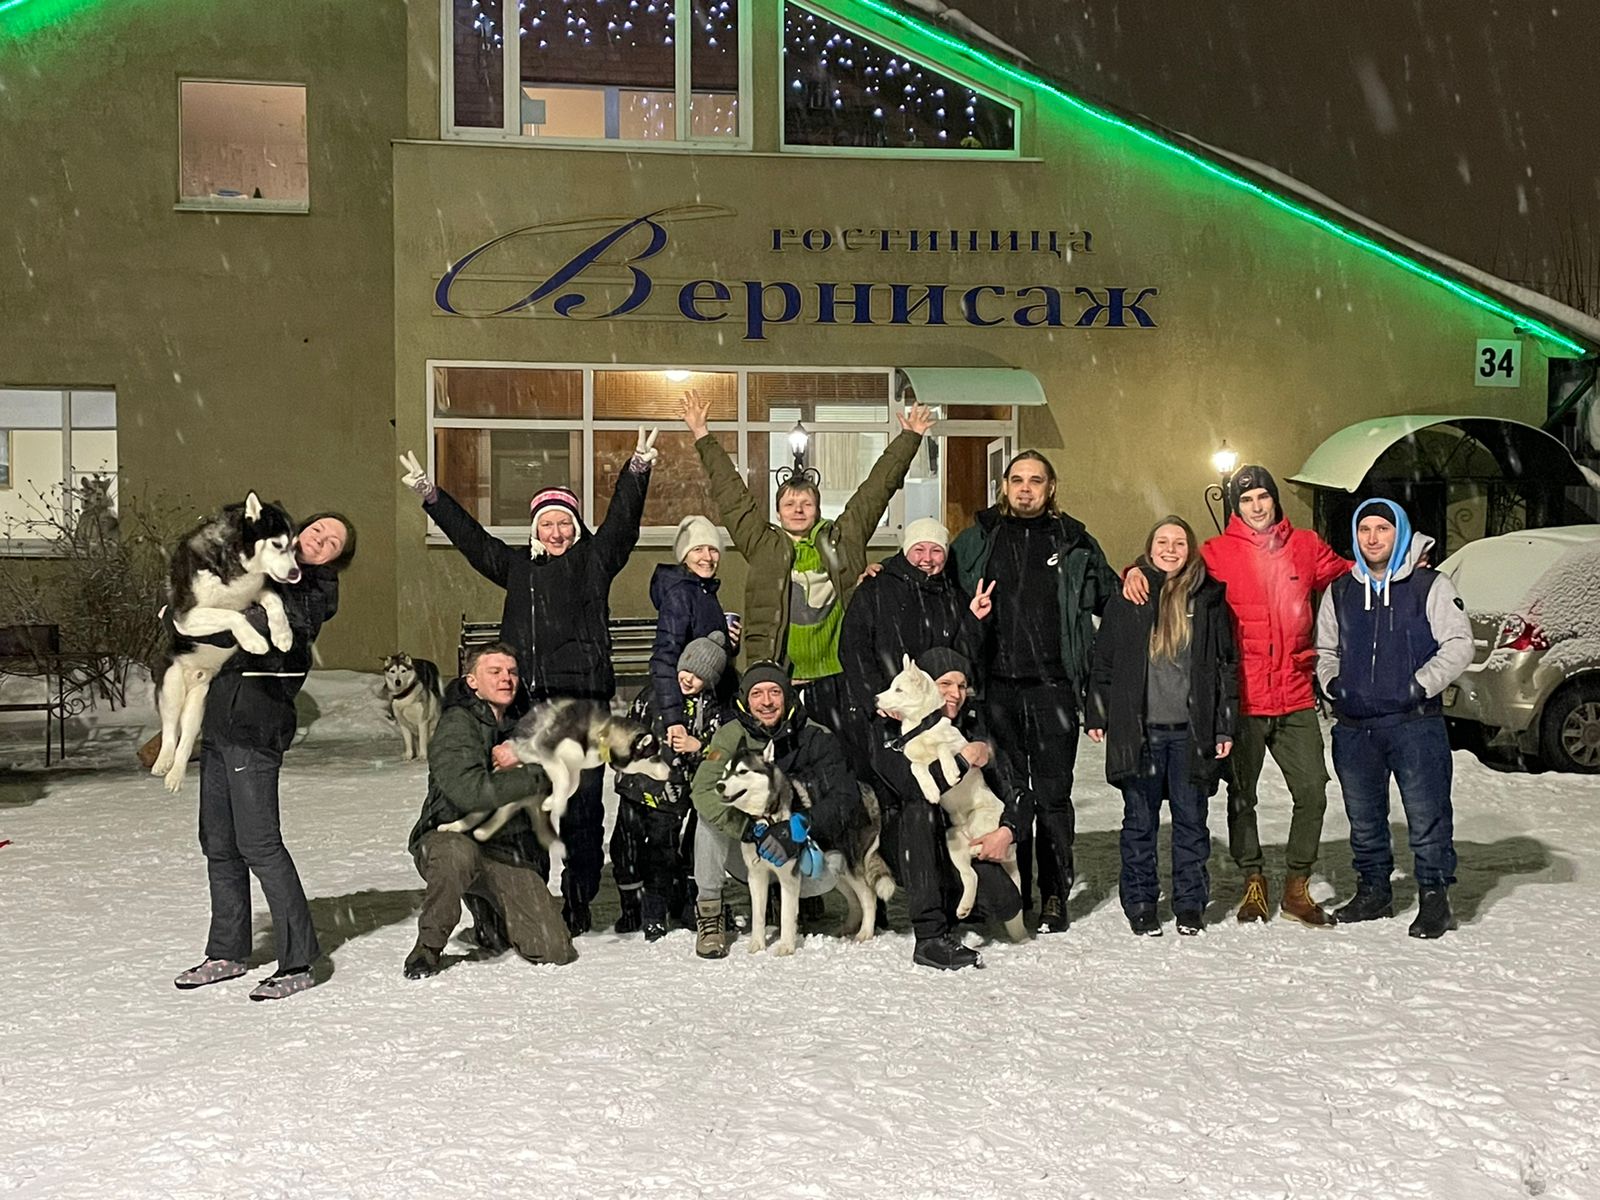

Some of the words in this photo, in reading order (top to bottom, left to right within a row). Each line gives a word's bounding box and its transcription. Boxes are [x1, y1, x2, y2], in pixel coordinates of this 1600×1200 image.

[771, 227, 1093, 258] гостиница
[434, 205, 1159, 341] Вернисаж
[1480, 347, 1514, 378] 34
